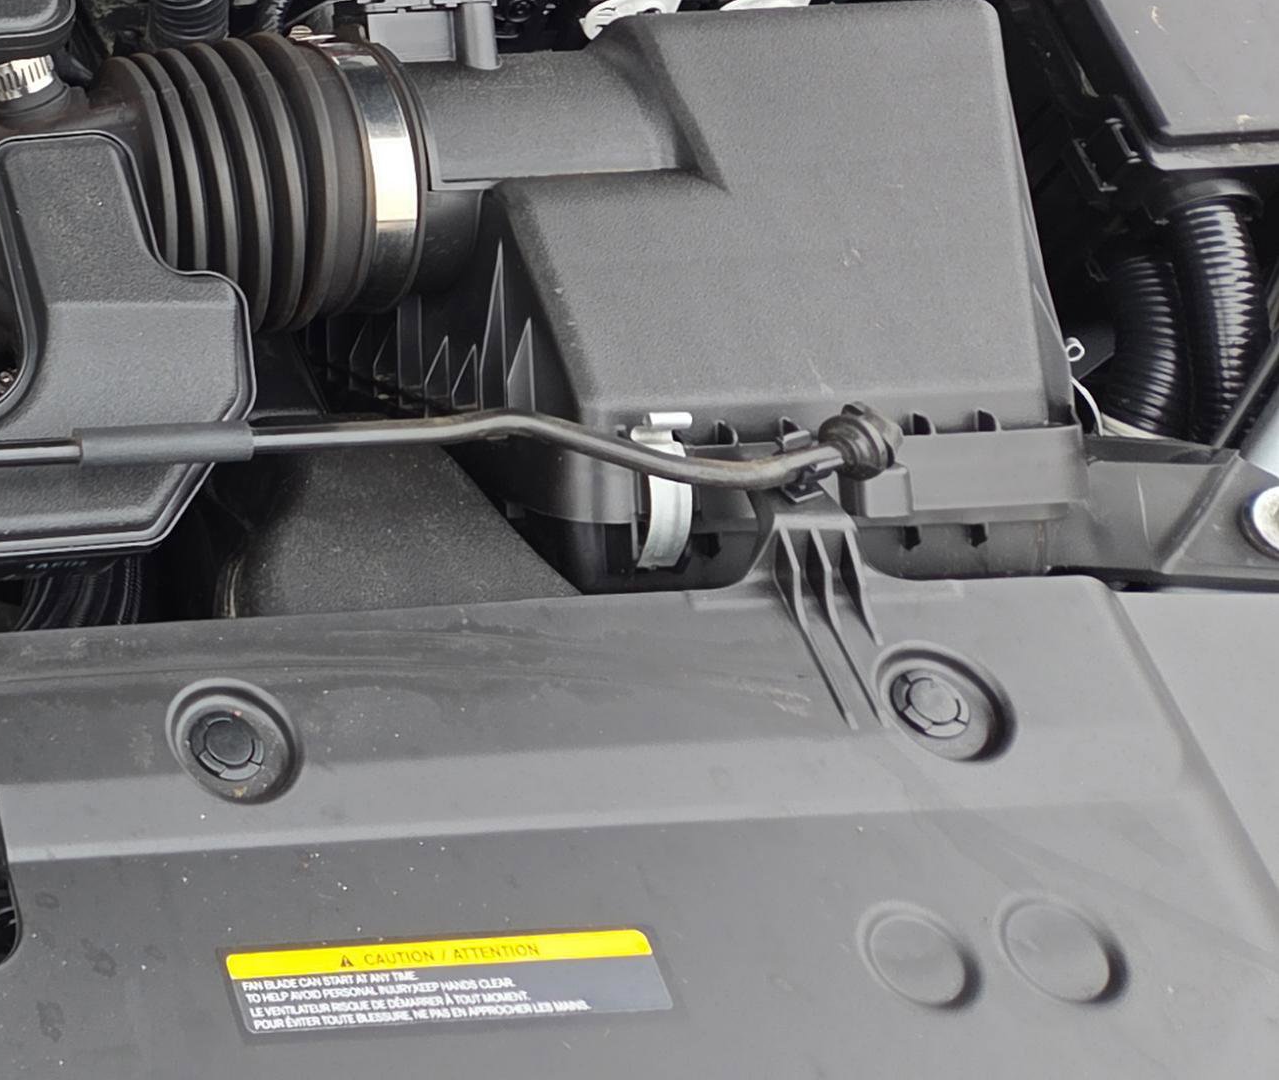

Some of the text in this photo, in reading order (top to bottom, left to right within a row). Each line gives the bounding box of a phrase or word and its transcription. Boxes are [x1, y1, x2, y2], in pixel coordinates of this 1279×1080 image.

[364, 949, 434, 966] CAUTION
[453, 944, 540, 960] ATTENTION
[242, 970, 419, 992] FAN BLADE CAN START AT ANY TIME.
[246, 993, 261, 1004] TO
[263, 990, 289, 1002] HELP
[290, 989, 322, 1001] AVOID
[324, 986, 378, 999] PERSONAL
[441, 978, 478, 991] HANDS
[478, 977, 516, 989] CLEAR.
[250, 990, 531, 1018] LE VENTILATEUR RISQUE DE DÉMARRER À TOUT MOMENT.
[254, 1018, 284, 1030] POUR
[286, 1014, 321, 1028] ÉVITER
[323, 1014, 352, 1026] TOUTE
[413, 1008, 429, 1020] NE
[430, 1006, 450, 1018] PAS
[451, 1005, 467, 1018] EN
[468, 1002, 532, 1016] APPROCHER
[533, 1001, 553, 1014] LES
